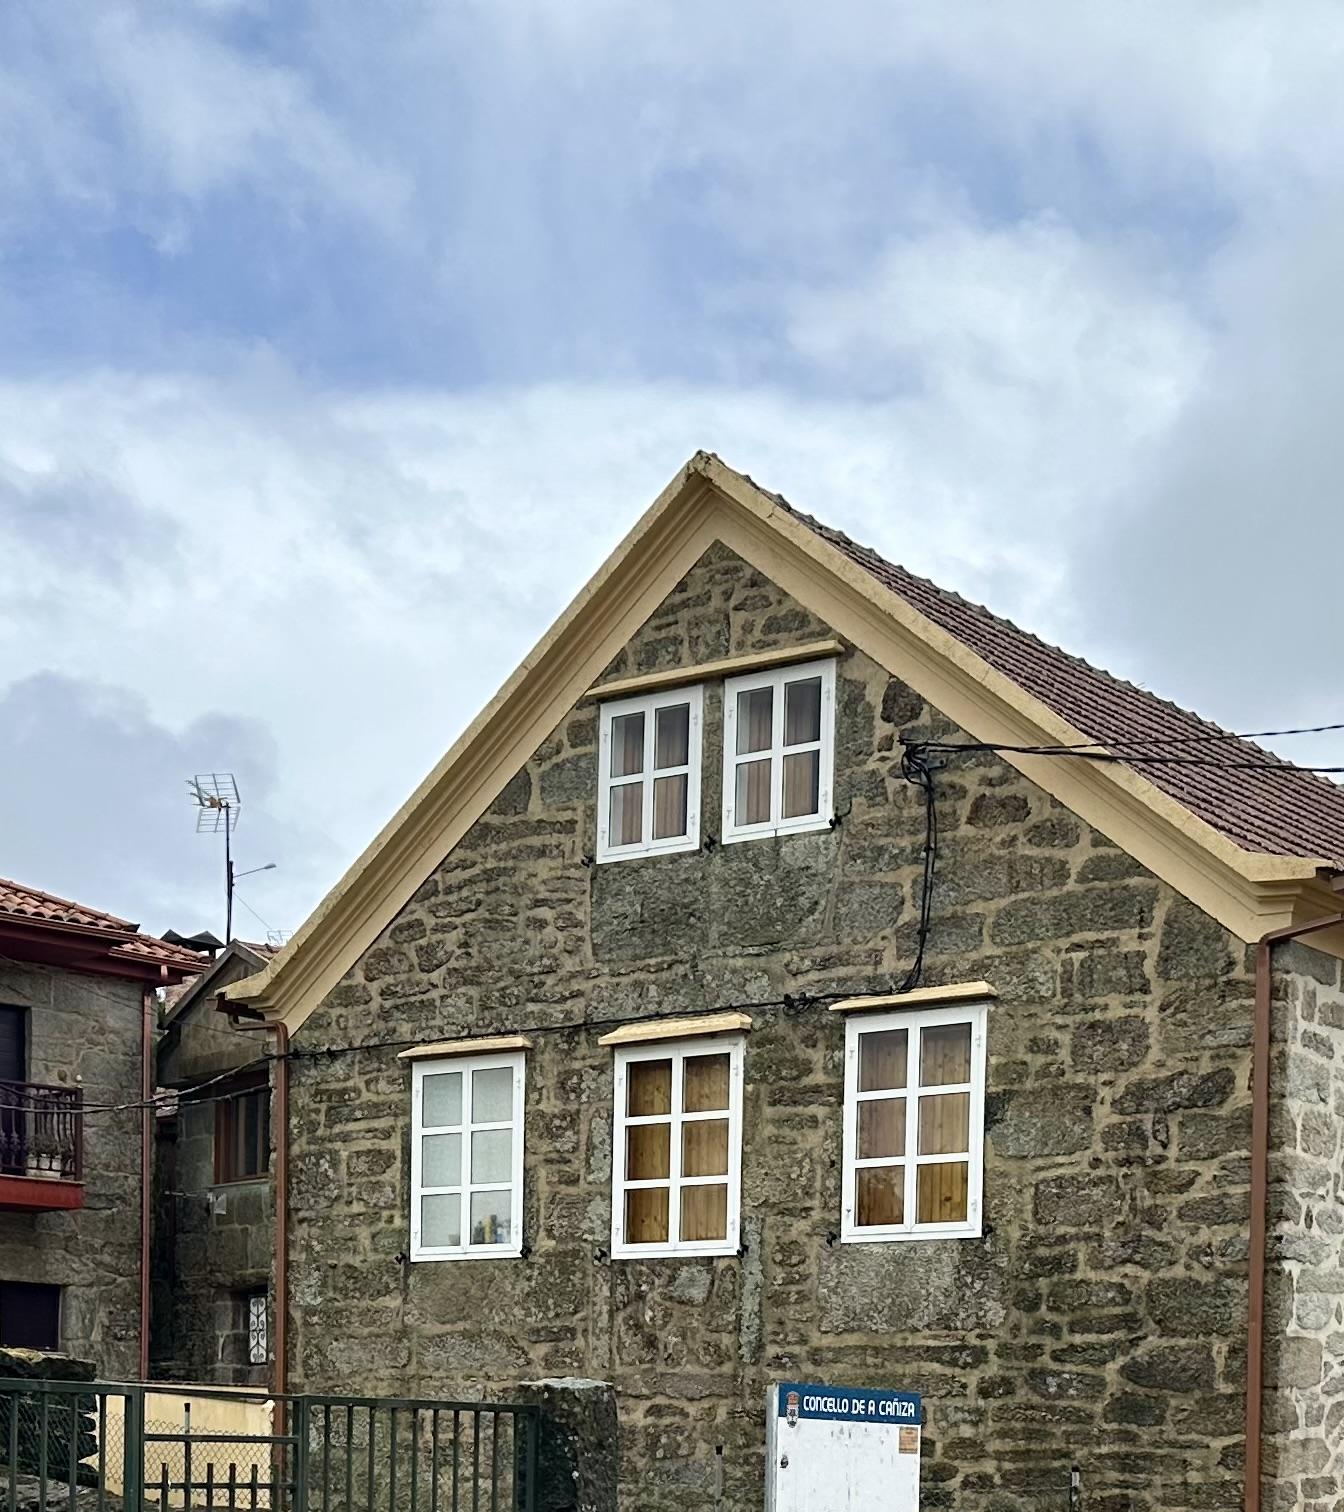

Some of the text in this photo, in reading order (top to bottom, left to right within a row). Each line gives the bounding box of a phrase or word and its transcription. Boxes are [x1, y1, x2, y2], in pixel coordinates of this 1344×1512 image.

[803, 1396, 914, 1417] CONCELLO DE A CAÑIZA
